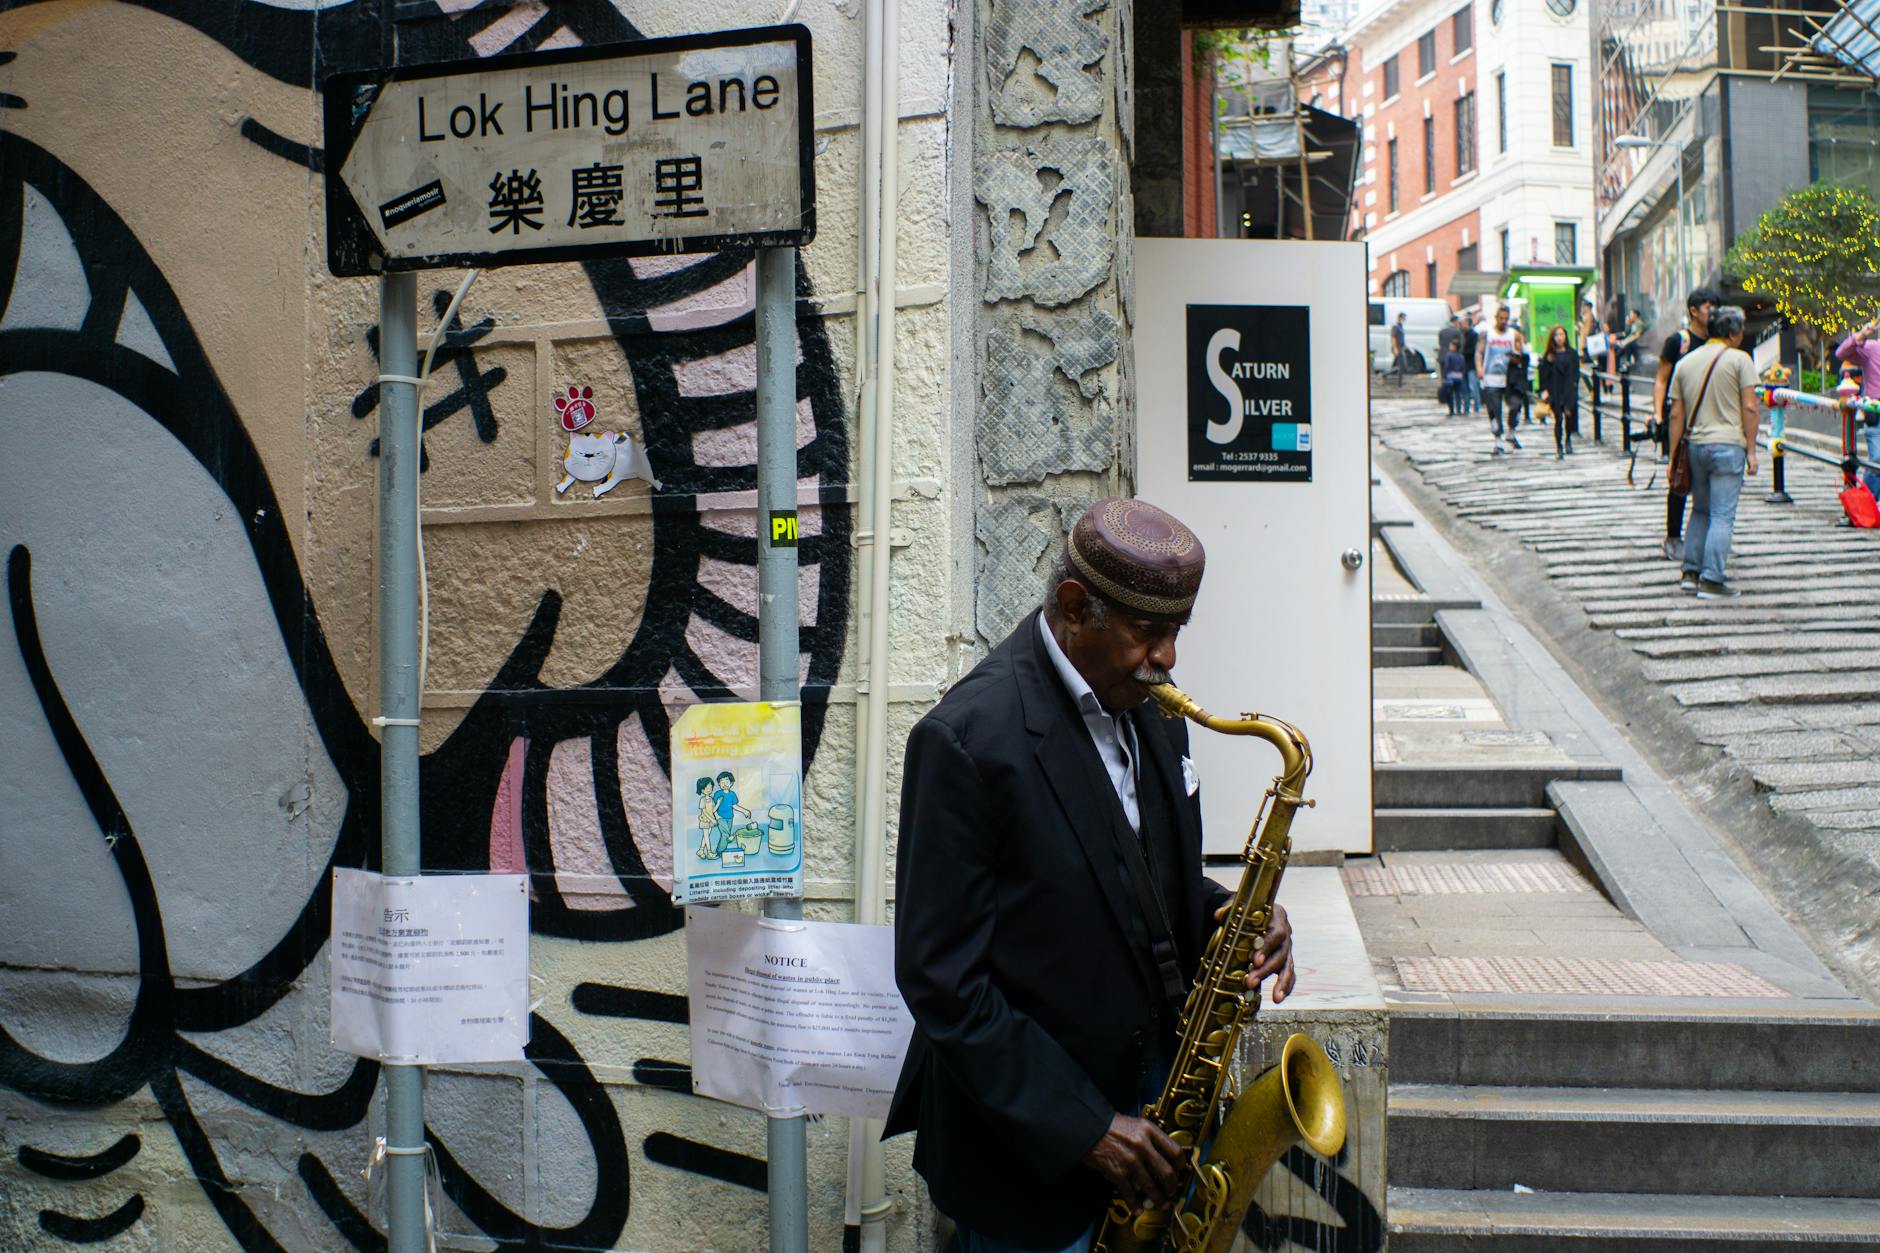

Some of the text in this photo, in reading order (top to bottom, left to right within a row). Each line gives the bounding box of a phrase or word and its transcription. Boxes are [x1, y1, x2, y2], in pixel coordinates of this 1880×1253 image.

[418, 72, 780, 142] Lok Hing Lane
[488, 157, 709, 235] 樂慶里
[1240, 452, 1258, 461] 2537
[1260, 452, 1279, 461] 9335
[384, 908, 409, 923] 告示
[764, 954, 807, 967] NOTICE
